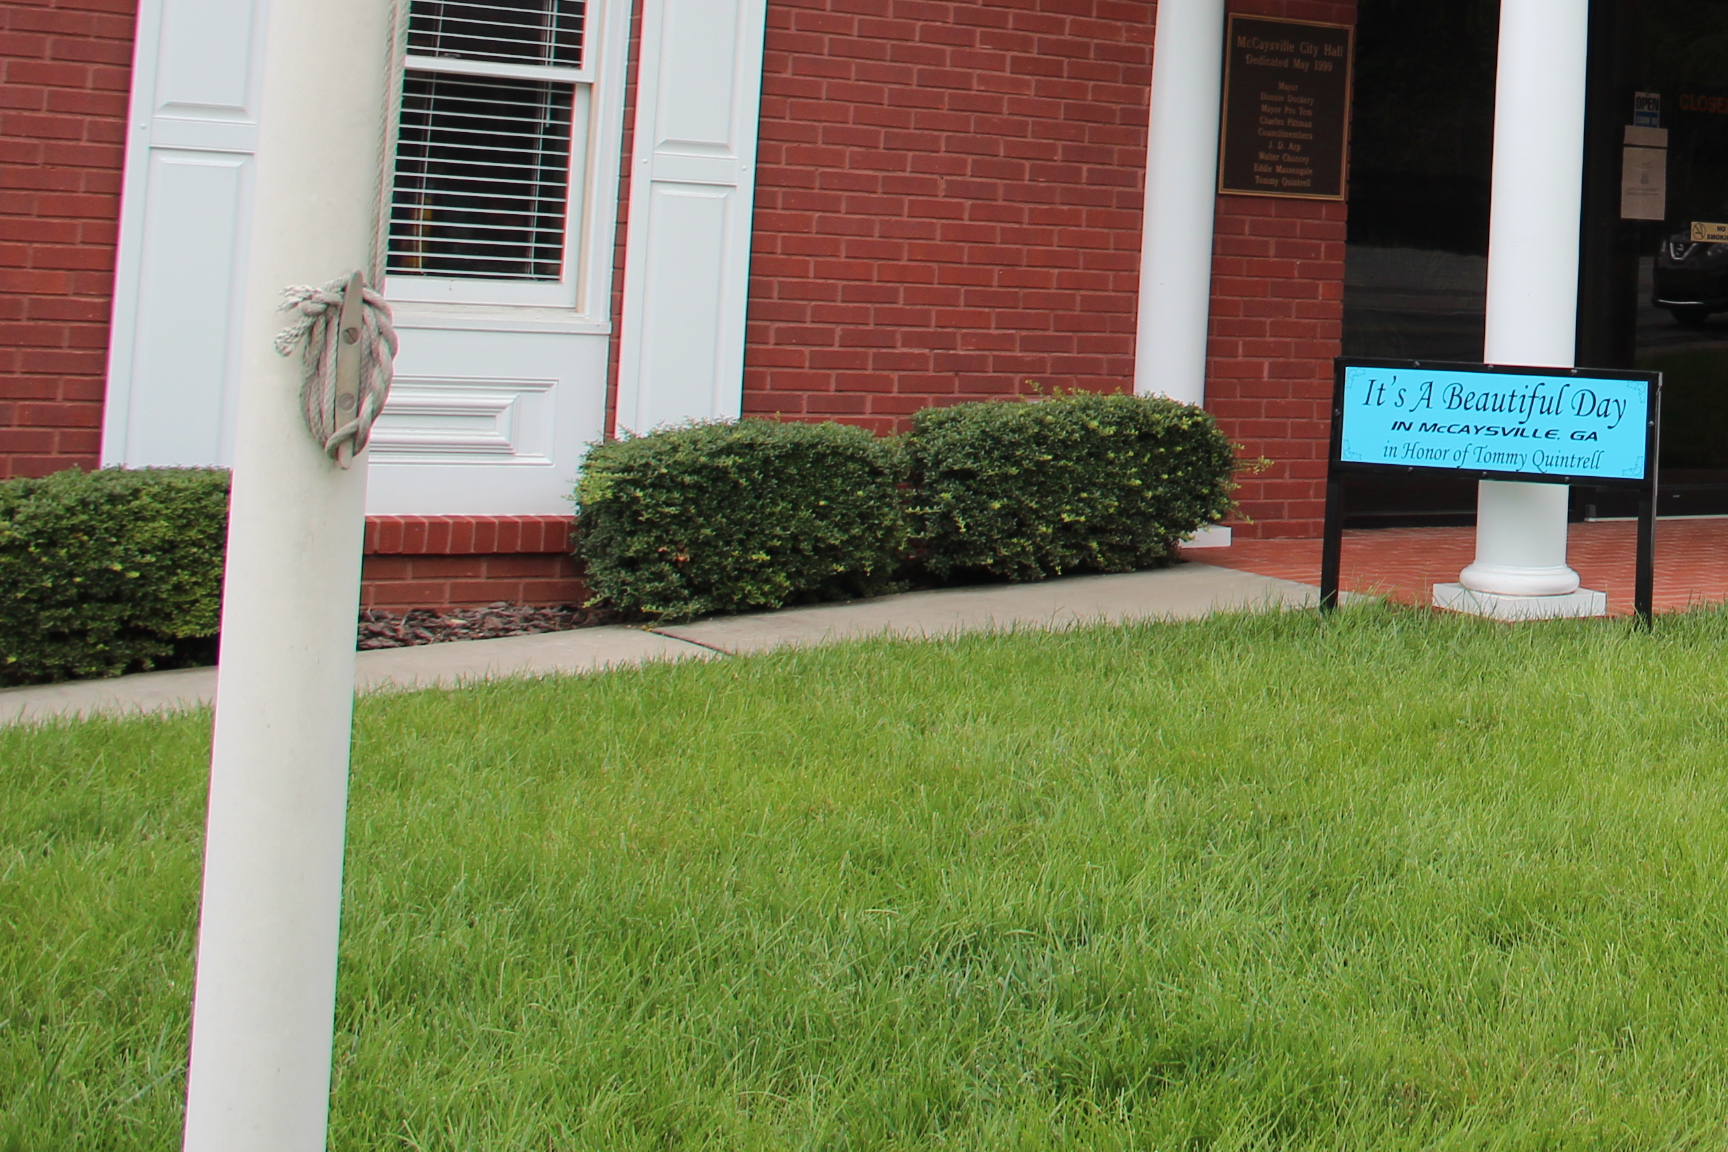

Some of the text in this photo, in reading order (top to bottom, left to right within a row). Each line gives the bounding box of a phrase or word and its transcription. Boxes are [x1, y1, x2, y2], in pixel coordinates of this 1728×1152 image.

[1237, 35, 1344, 58] McCaysville City Hall
[1246, 53, 1333, 72] Dedicated May 1999
[1278, 81, 1299, 93] Mayor
[1261, 104, 1282, 115] Mayor
[1635, 96, 1660, 112] OPEN
[1259, 115, 1285, 126] Charles
[1254, 175, 1279, 187] Tommy
[1716, 225, 1727, 233] NO
[1361, 375, 1627, 430] It's A Beautiful Day
[1390, 420, 1414, 432] IN
[1569, 430, 1599, 442] GA
[1383, 440, 1606, 474] in Honor of Tommy Quintrell
